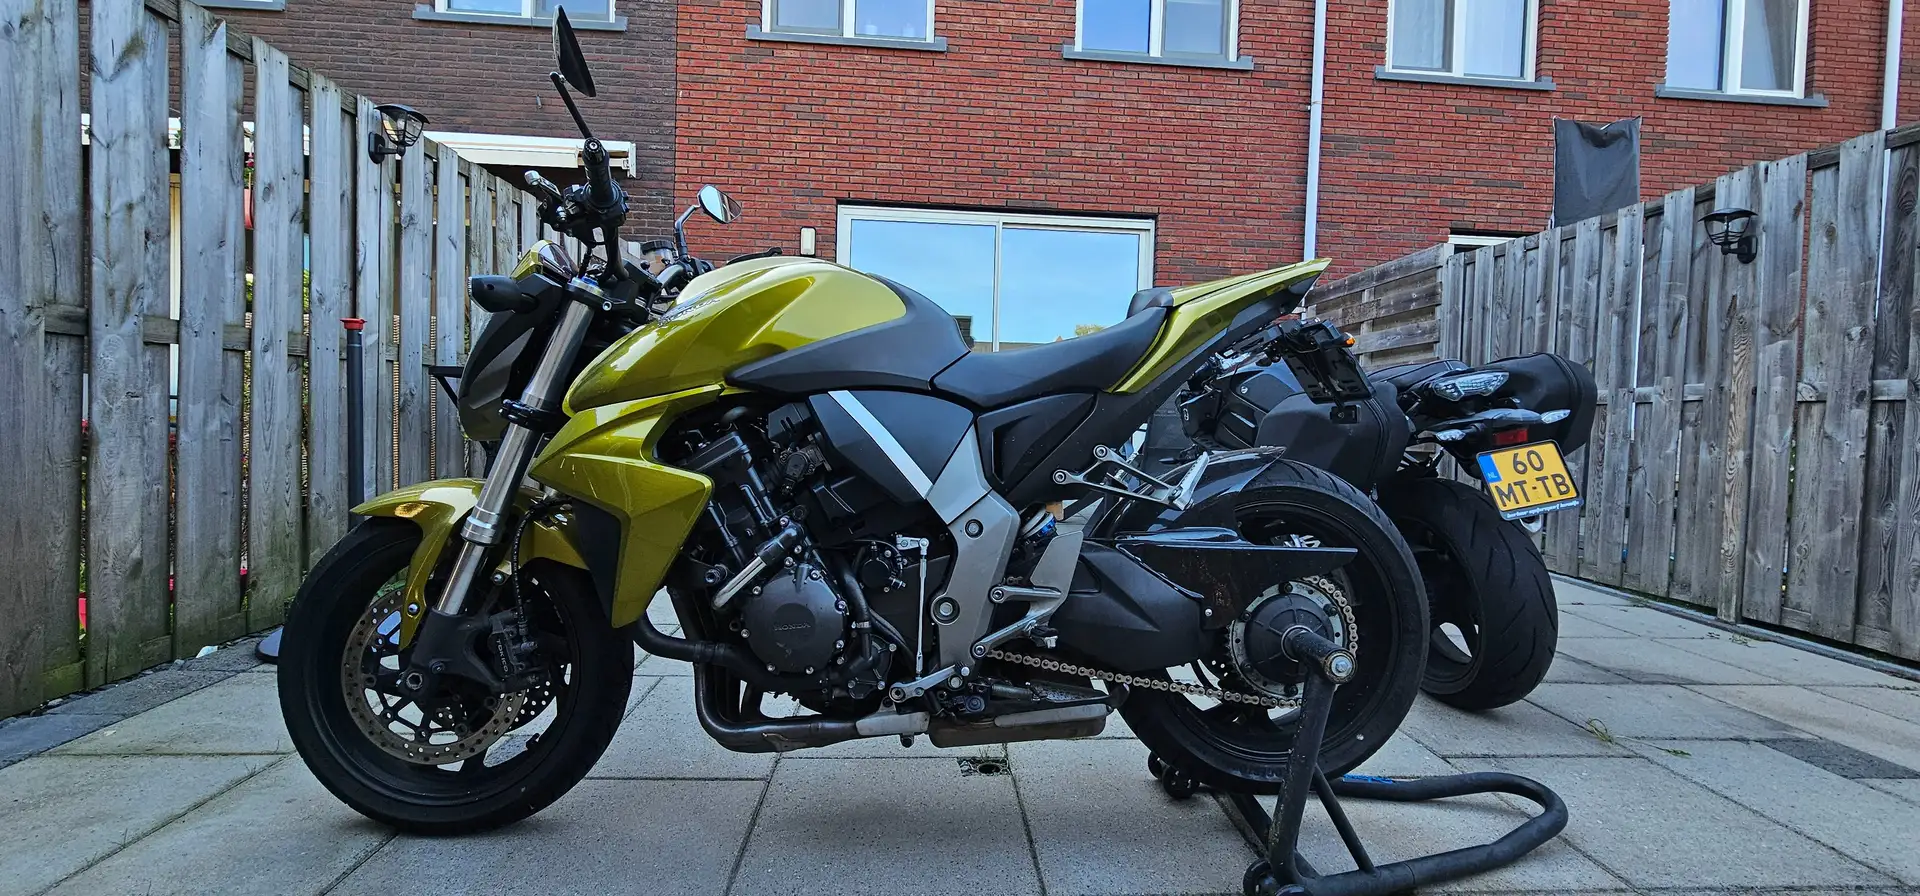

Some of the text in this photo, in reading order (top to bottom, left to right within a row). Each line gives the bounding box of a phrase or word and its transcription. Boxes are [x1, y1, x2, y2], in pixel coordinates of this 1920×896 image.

[1512, 449, 1545, 474] 60
[1487, 471, 1498, 479] NL
[774, 622, 811, 631] HONDA
[496, 639, 509, 673] TOKICO
